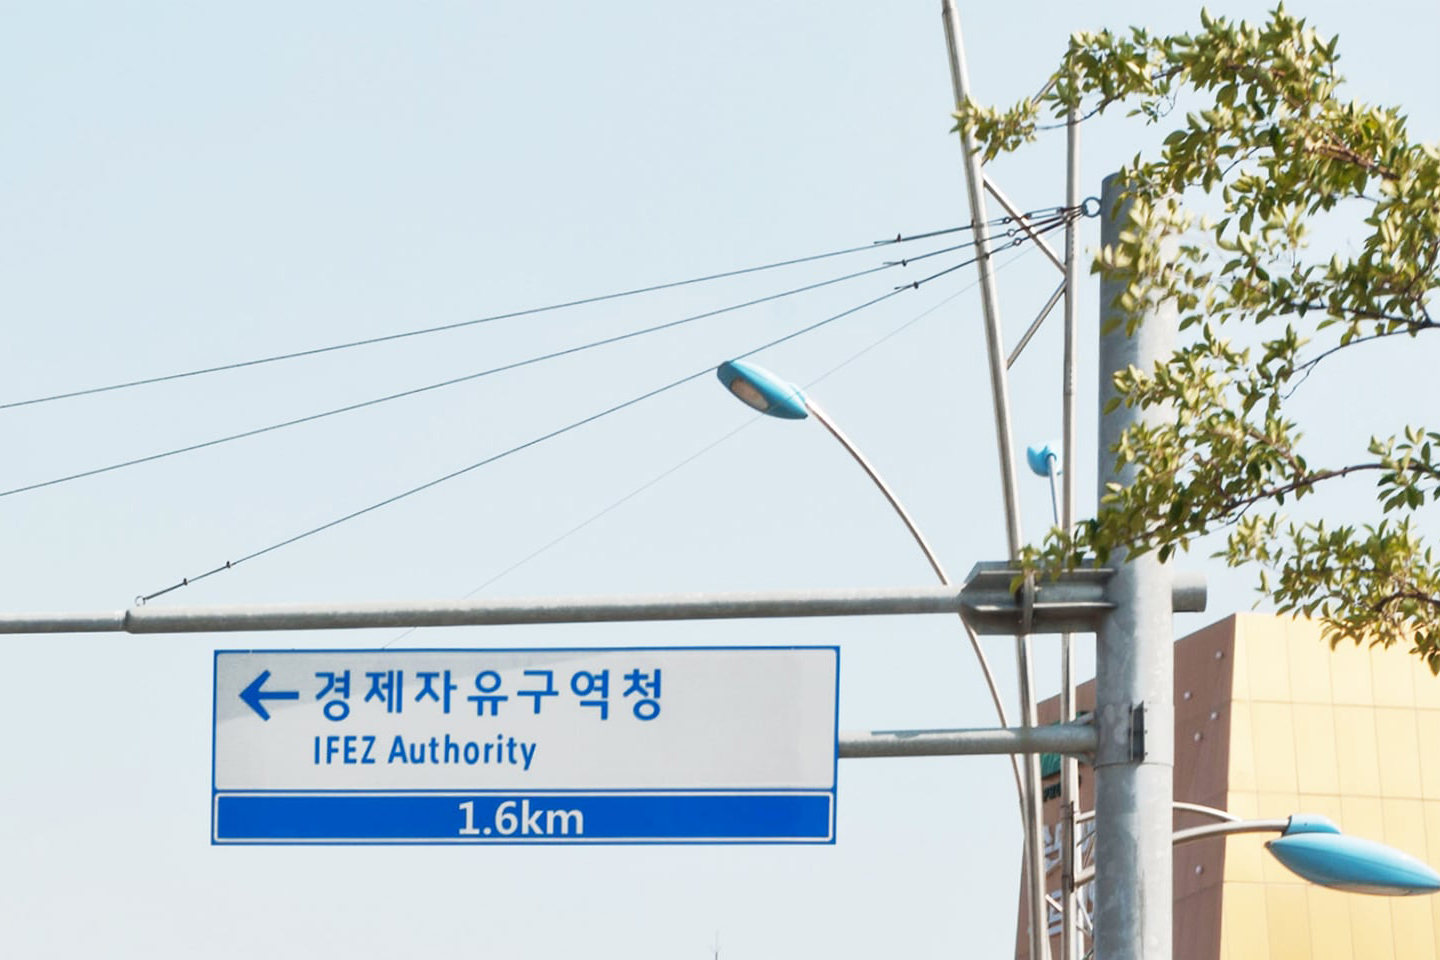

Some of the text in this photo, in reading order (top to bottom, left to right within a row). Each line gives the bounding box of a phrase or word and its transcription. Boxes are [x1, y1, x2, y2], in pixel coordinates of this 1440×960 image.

[314, 667, 663, 722] 경제자유구역청
[314, 734, 537, 771] IFEZ Authority
[457, 800, 585, 836] 1.6km
